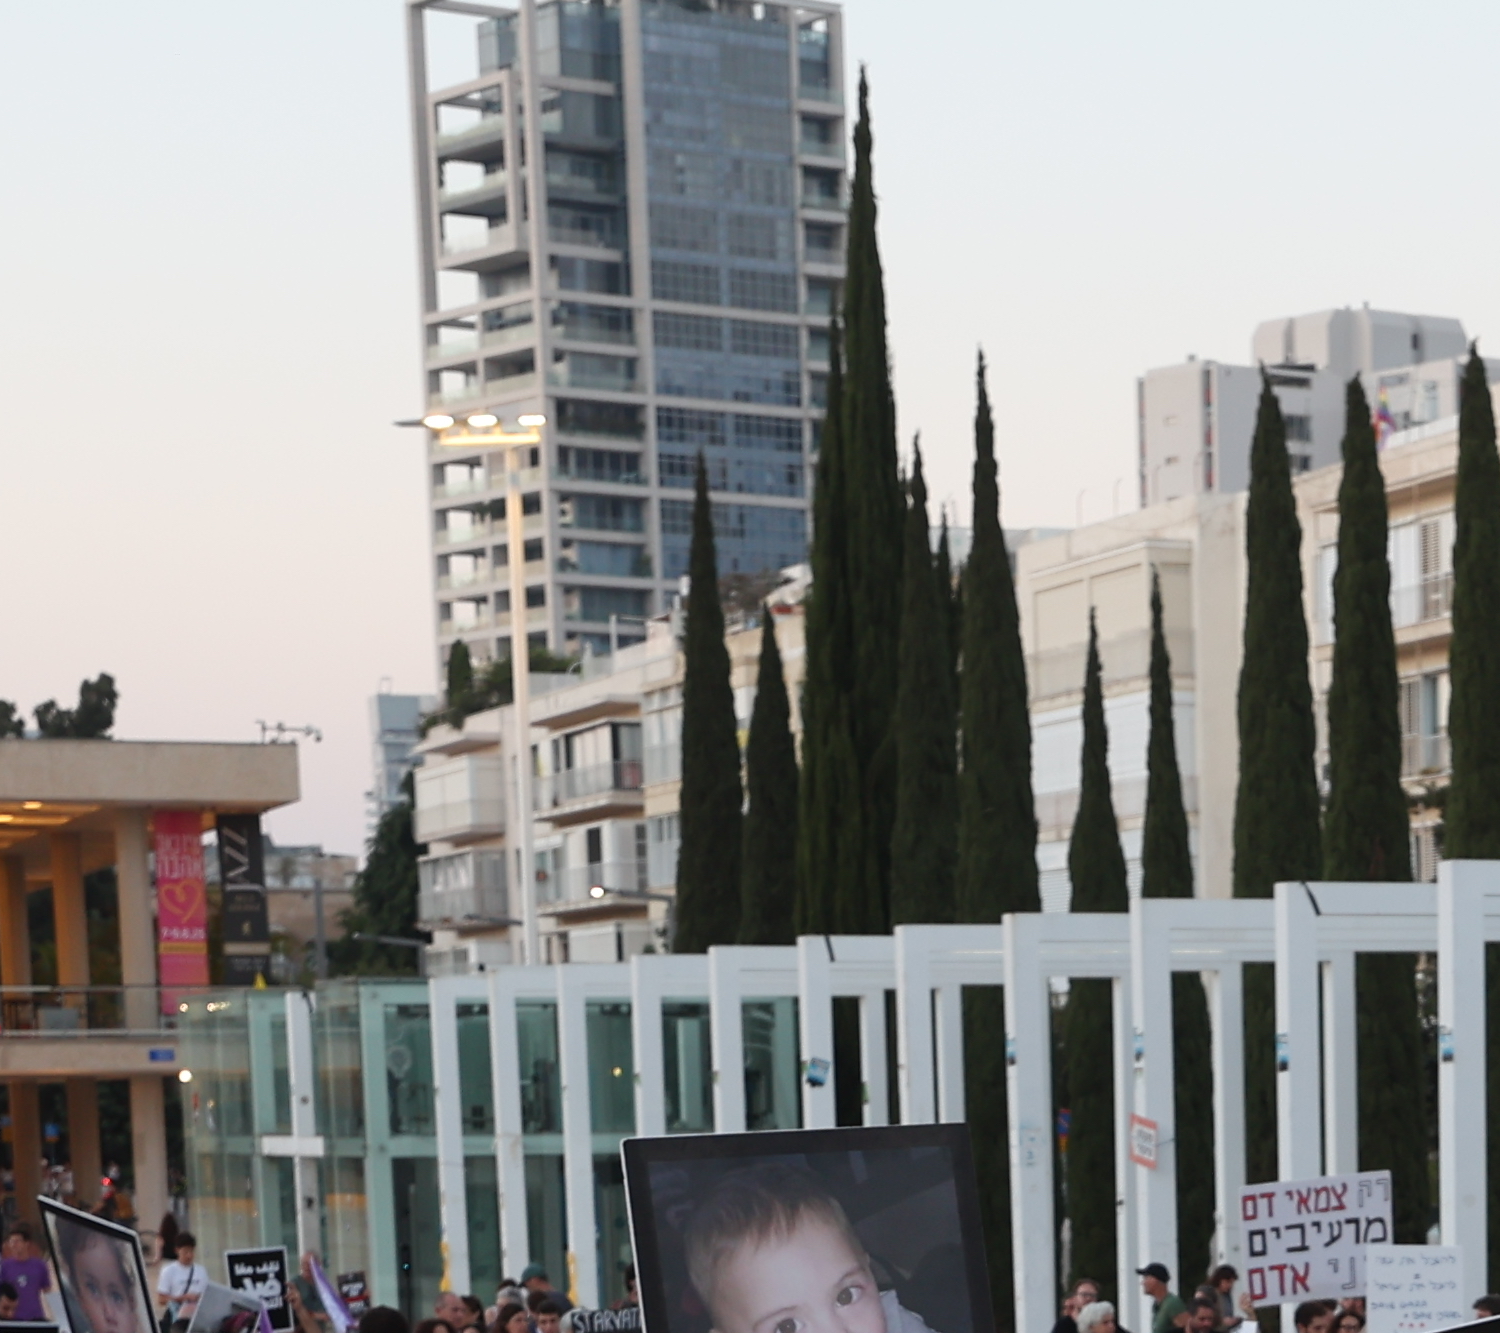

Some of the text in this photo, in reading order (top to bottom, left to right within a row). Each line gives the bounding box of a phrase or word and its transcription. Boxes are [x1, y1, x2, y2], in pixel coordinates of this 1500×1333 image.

[1242, 1178, 1389, 1221] רק צמאי דם
[1248, 1216, 1388, 1258] מרעיבים
[1248, 1261, 1311, 1302] אדם
